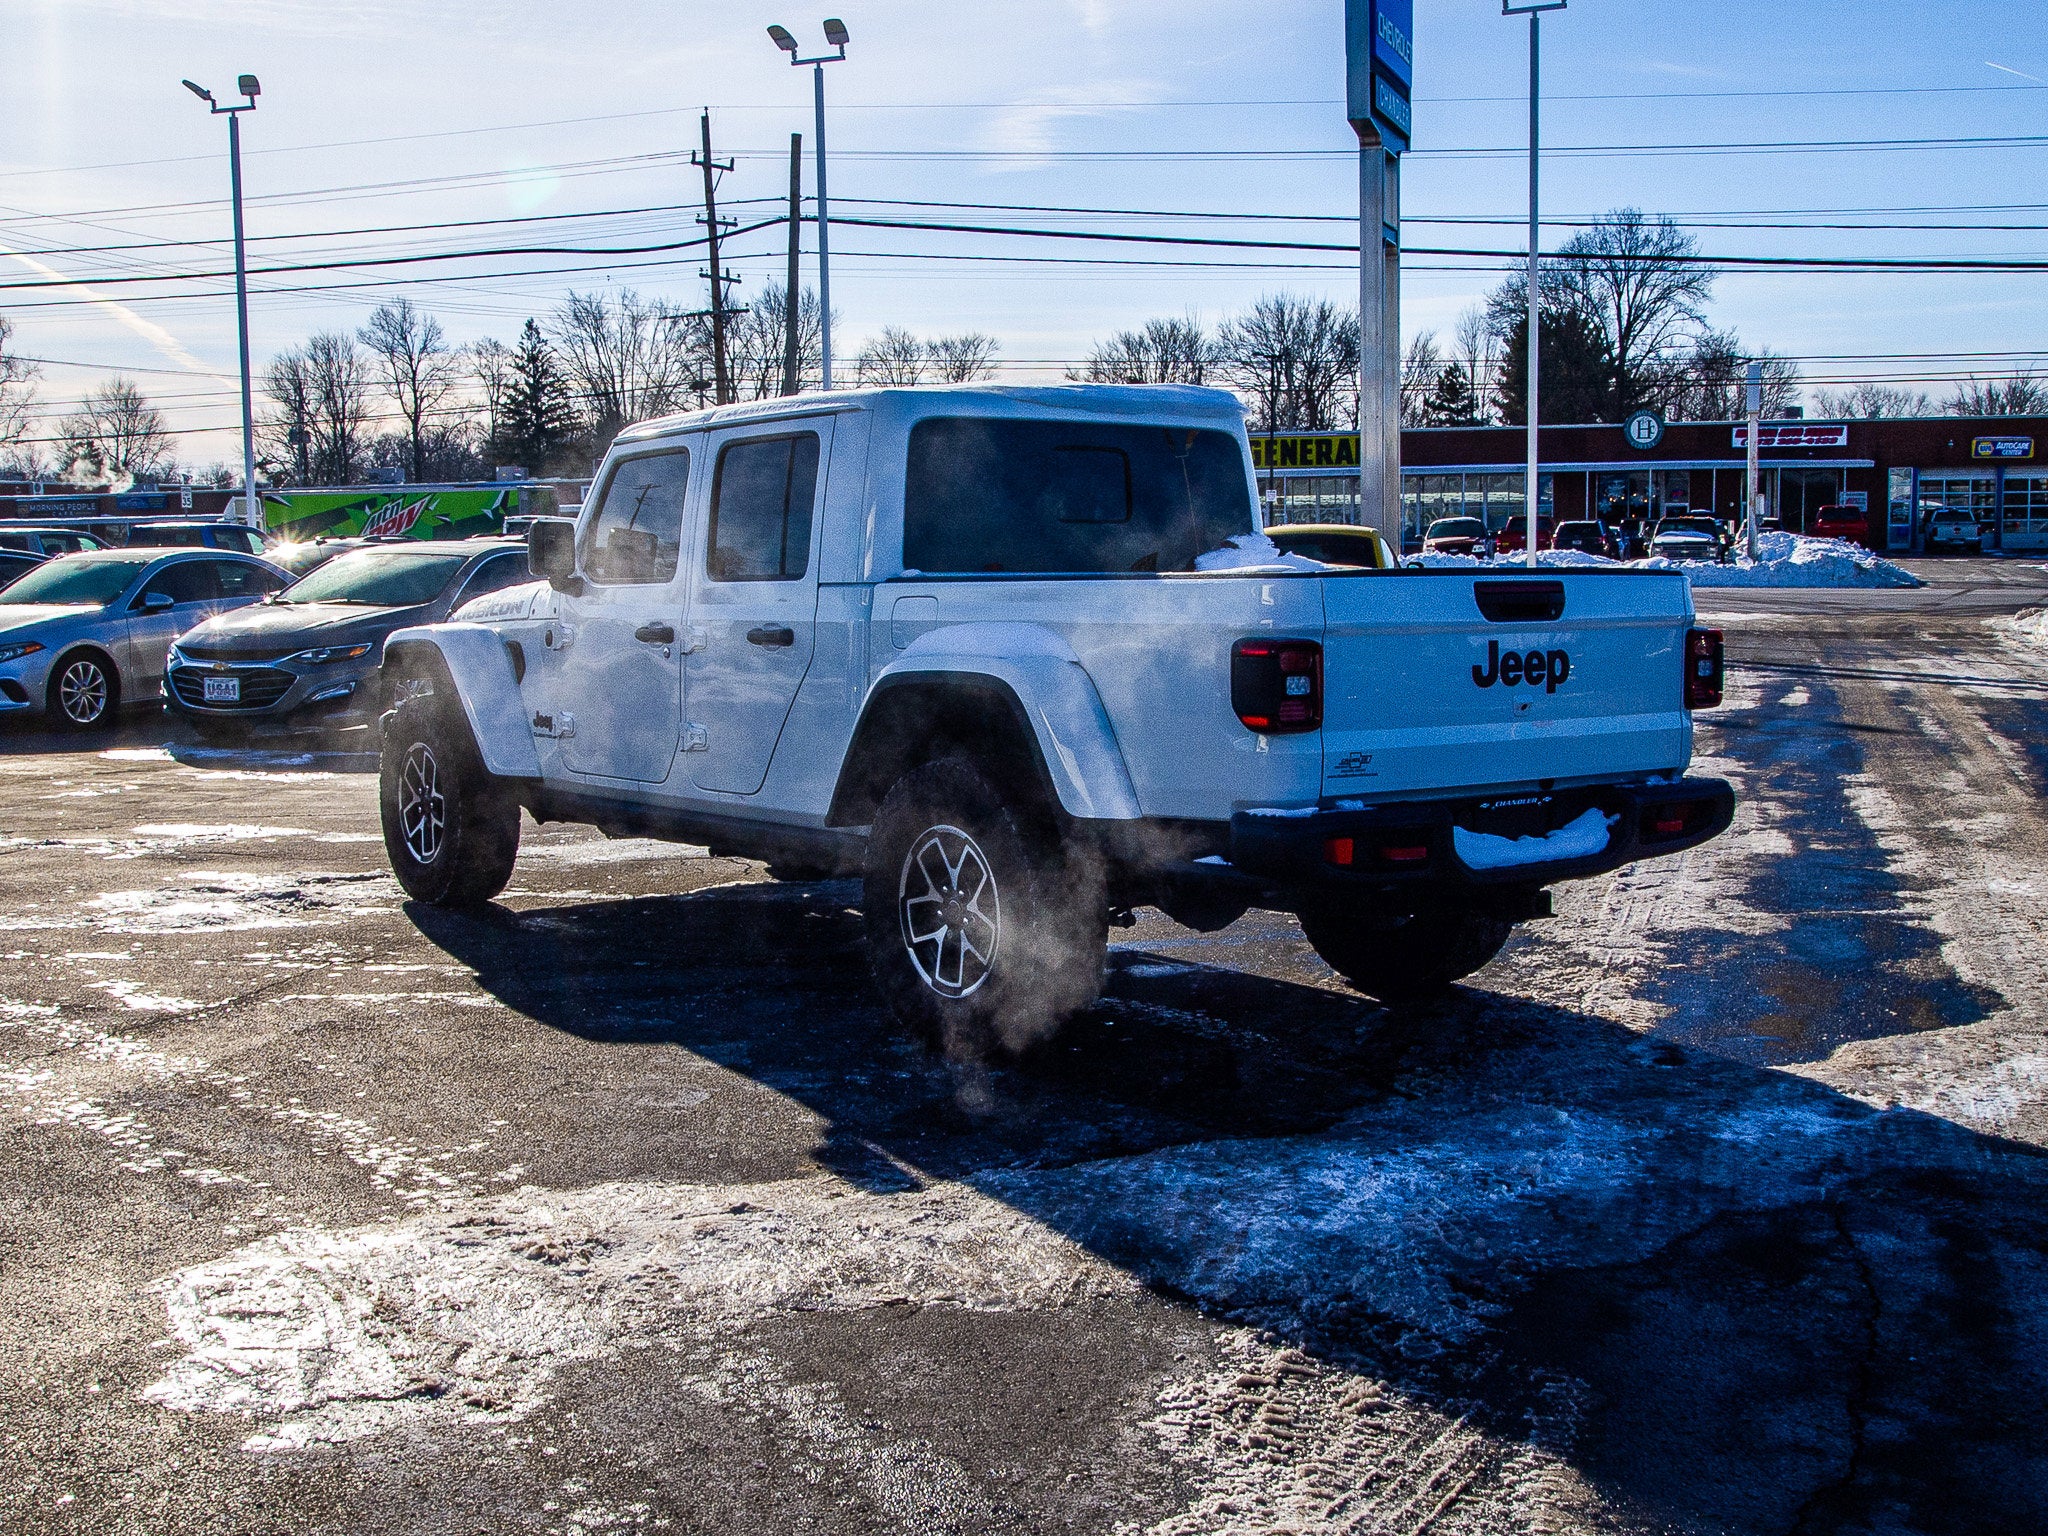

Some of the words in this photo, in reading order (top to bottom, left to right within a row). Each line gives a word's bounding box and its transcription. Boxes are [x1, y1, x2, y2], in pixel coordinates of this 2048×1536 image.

[1377, 12, 1412, 65] CHEVROLET
[67, 502, 96, 510] PEOPLE
[182, 497, 192, 506] 35
[1472, 640, 1570, 694] Jeep
[207, 683, 236, 696] USA1
[1495, 797, 1538, 807] CHANDLER
